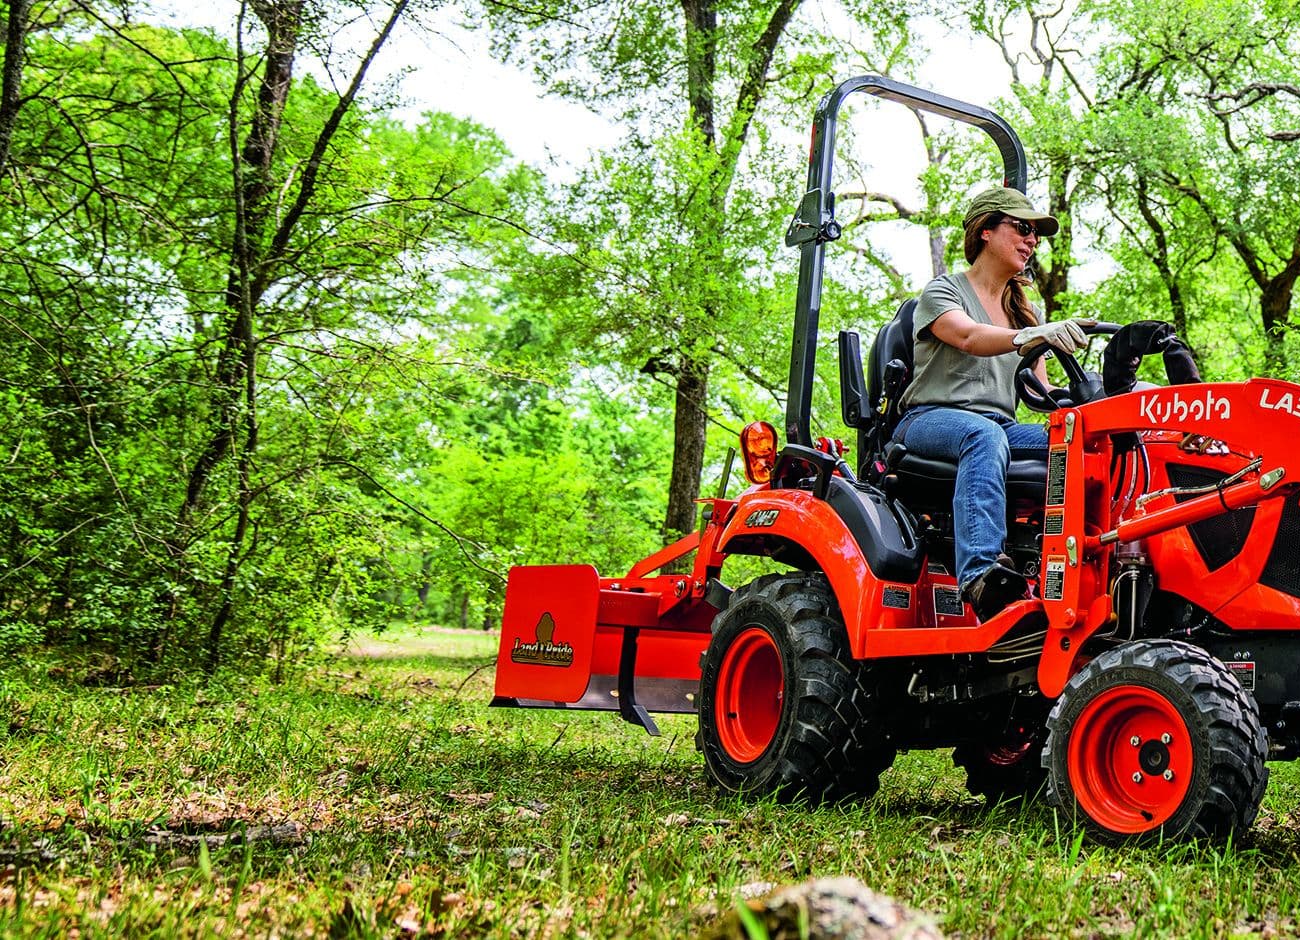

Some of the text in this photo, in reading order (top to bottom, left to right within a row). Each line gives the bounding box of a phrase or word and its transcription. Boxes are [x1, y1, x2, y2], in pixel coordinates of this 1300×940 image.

[1140, 390, 1231, 424] Kubota
[745, 509, 780, 527] 4WD
[512, 638, 573, 661] Land Pride
